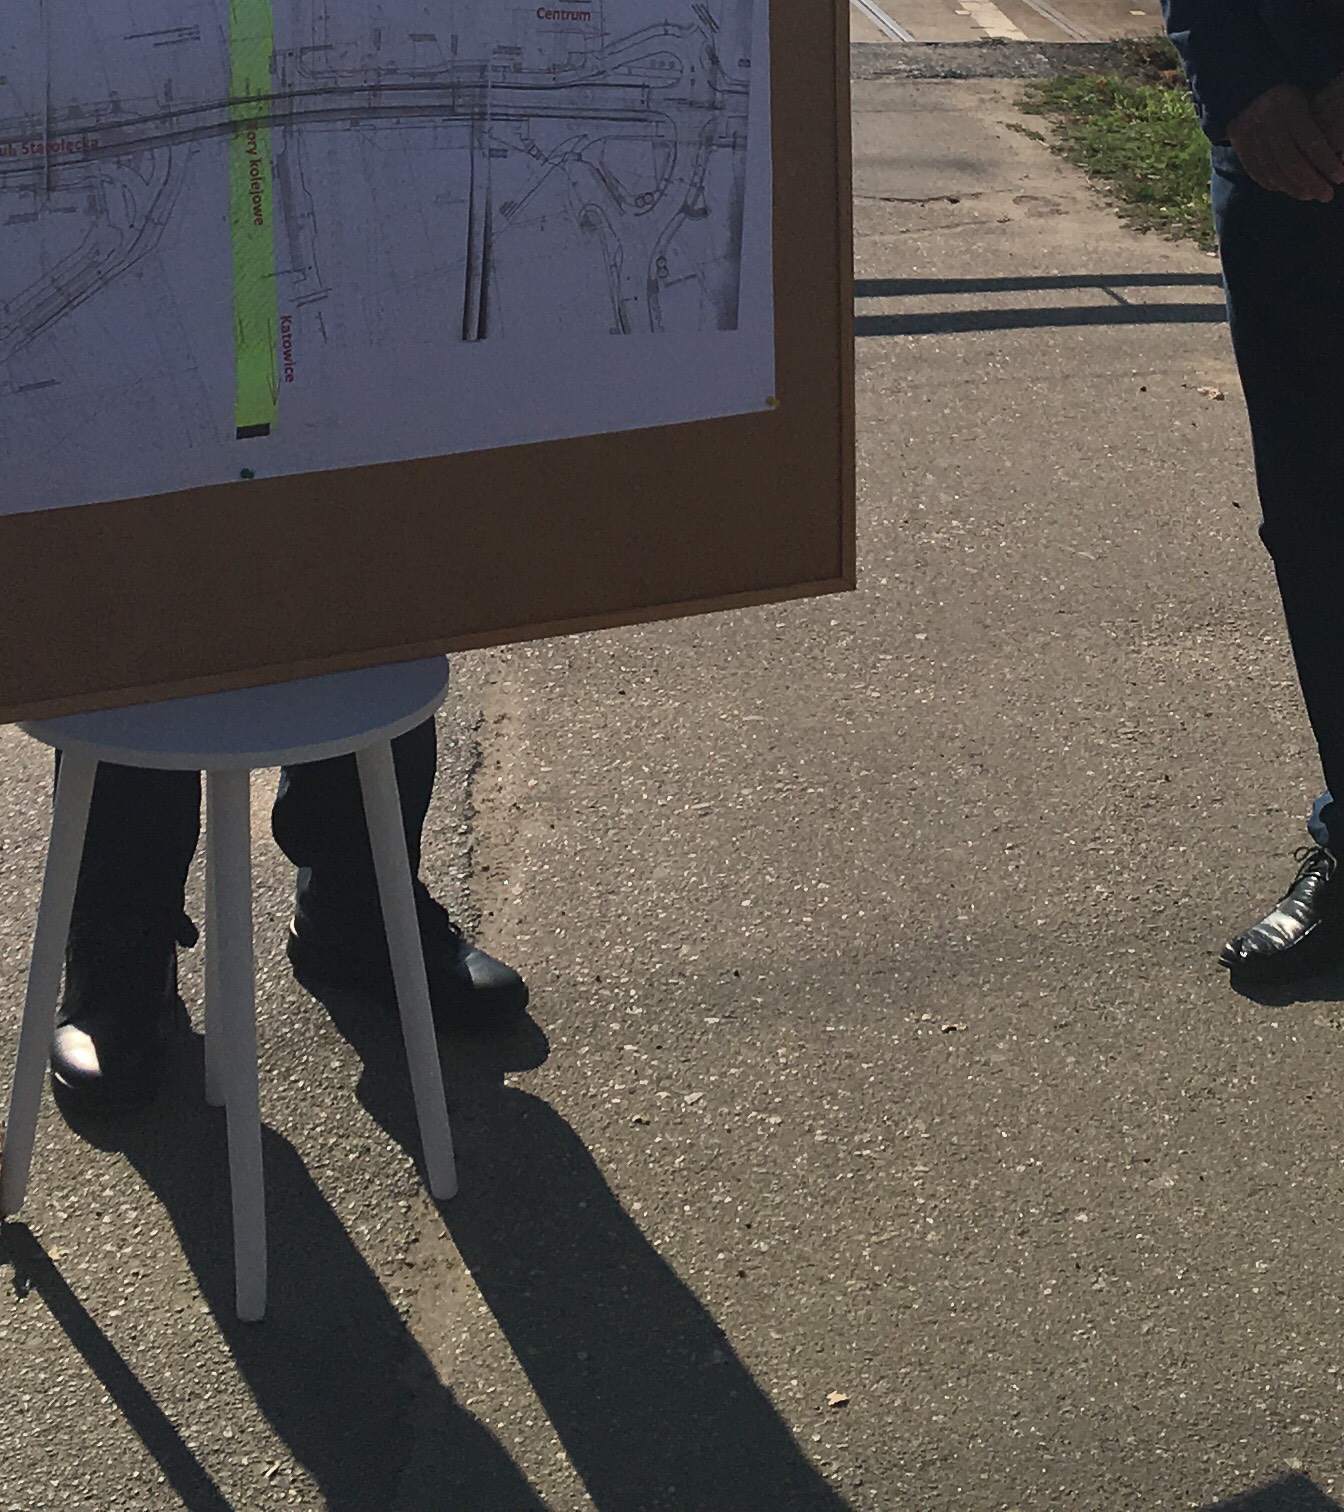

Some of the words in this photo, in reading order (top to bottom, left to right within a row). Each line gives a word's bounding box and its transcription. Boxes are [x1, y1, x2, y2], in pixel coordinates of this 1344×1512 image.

[536, 7, 591, 21] Centrum
[248, 159, 265, 227] kolejowe
[280, 315, 296, 383] Katowice
